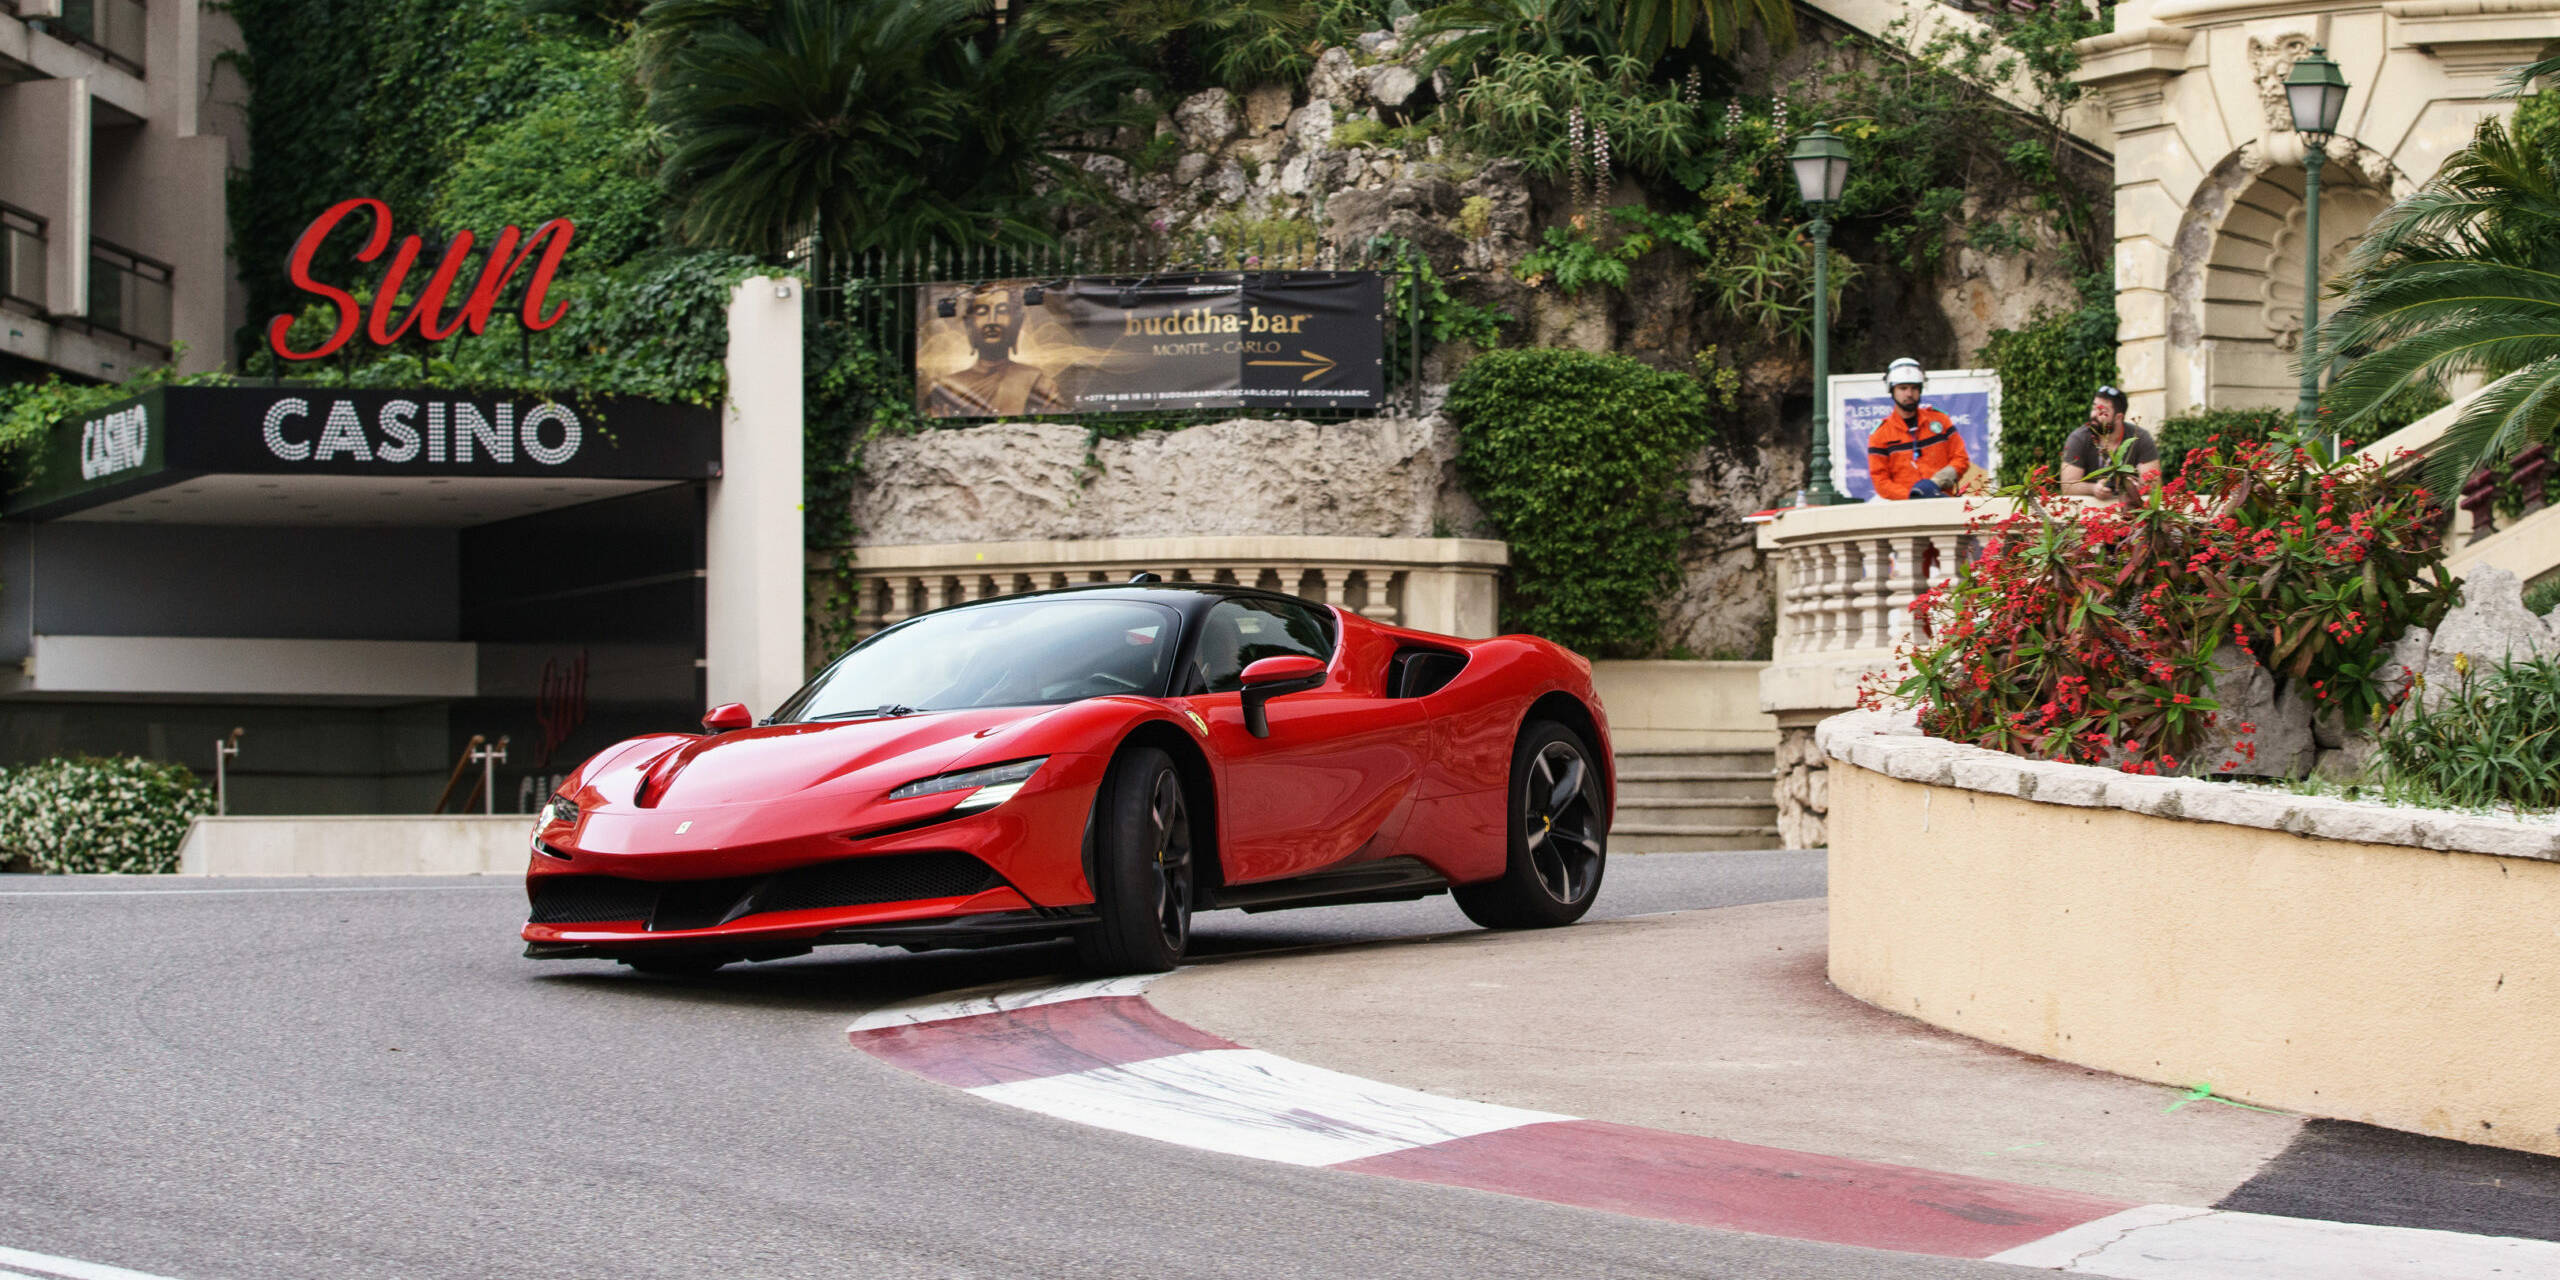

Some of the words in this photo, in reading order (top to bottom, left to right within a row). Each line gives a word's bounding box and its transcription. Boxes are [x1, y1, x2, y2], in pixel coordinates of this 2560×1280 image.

[271, 198, 575, 361] Sun
[1152, 342, 1211, 356] MONTE
[1223, 341, 1281, 354] CARLO
[81, 404, 148, 480] CASINO
[263, 397, 582, 466] CASINO
